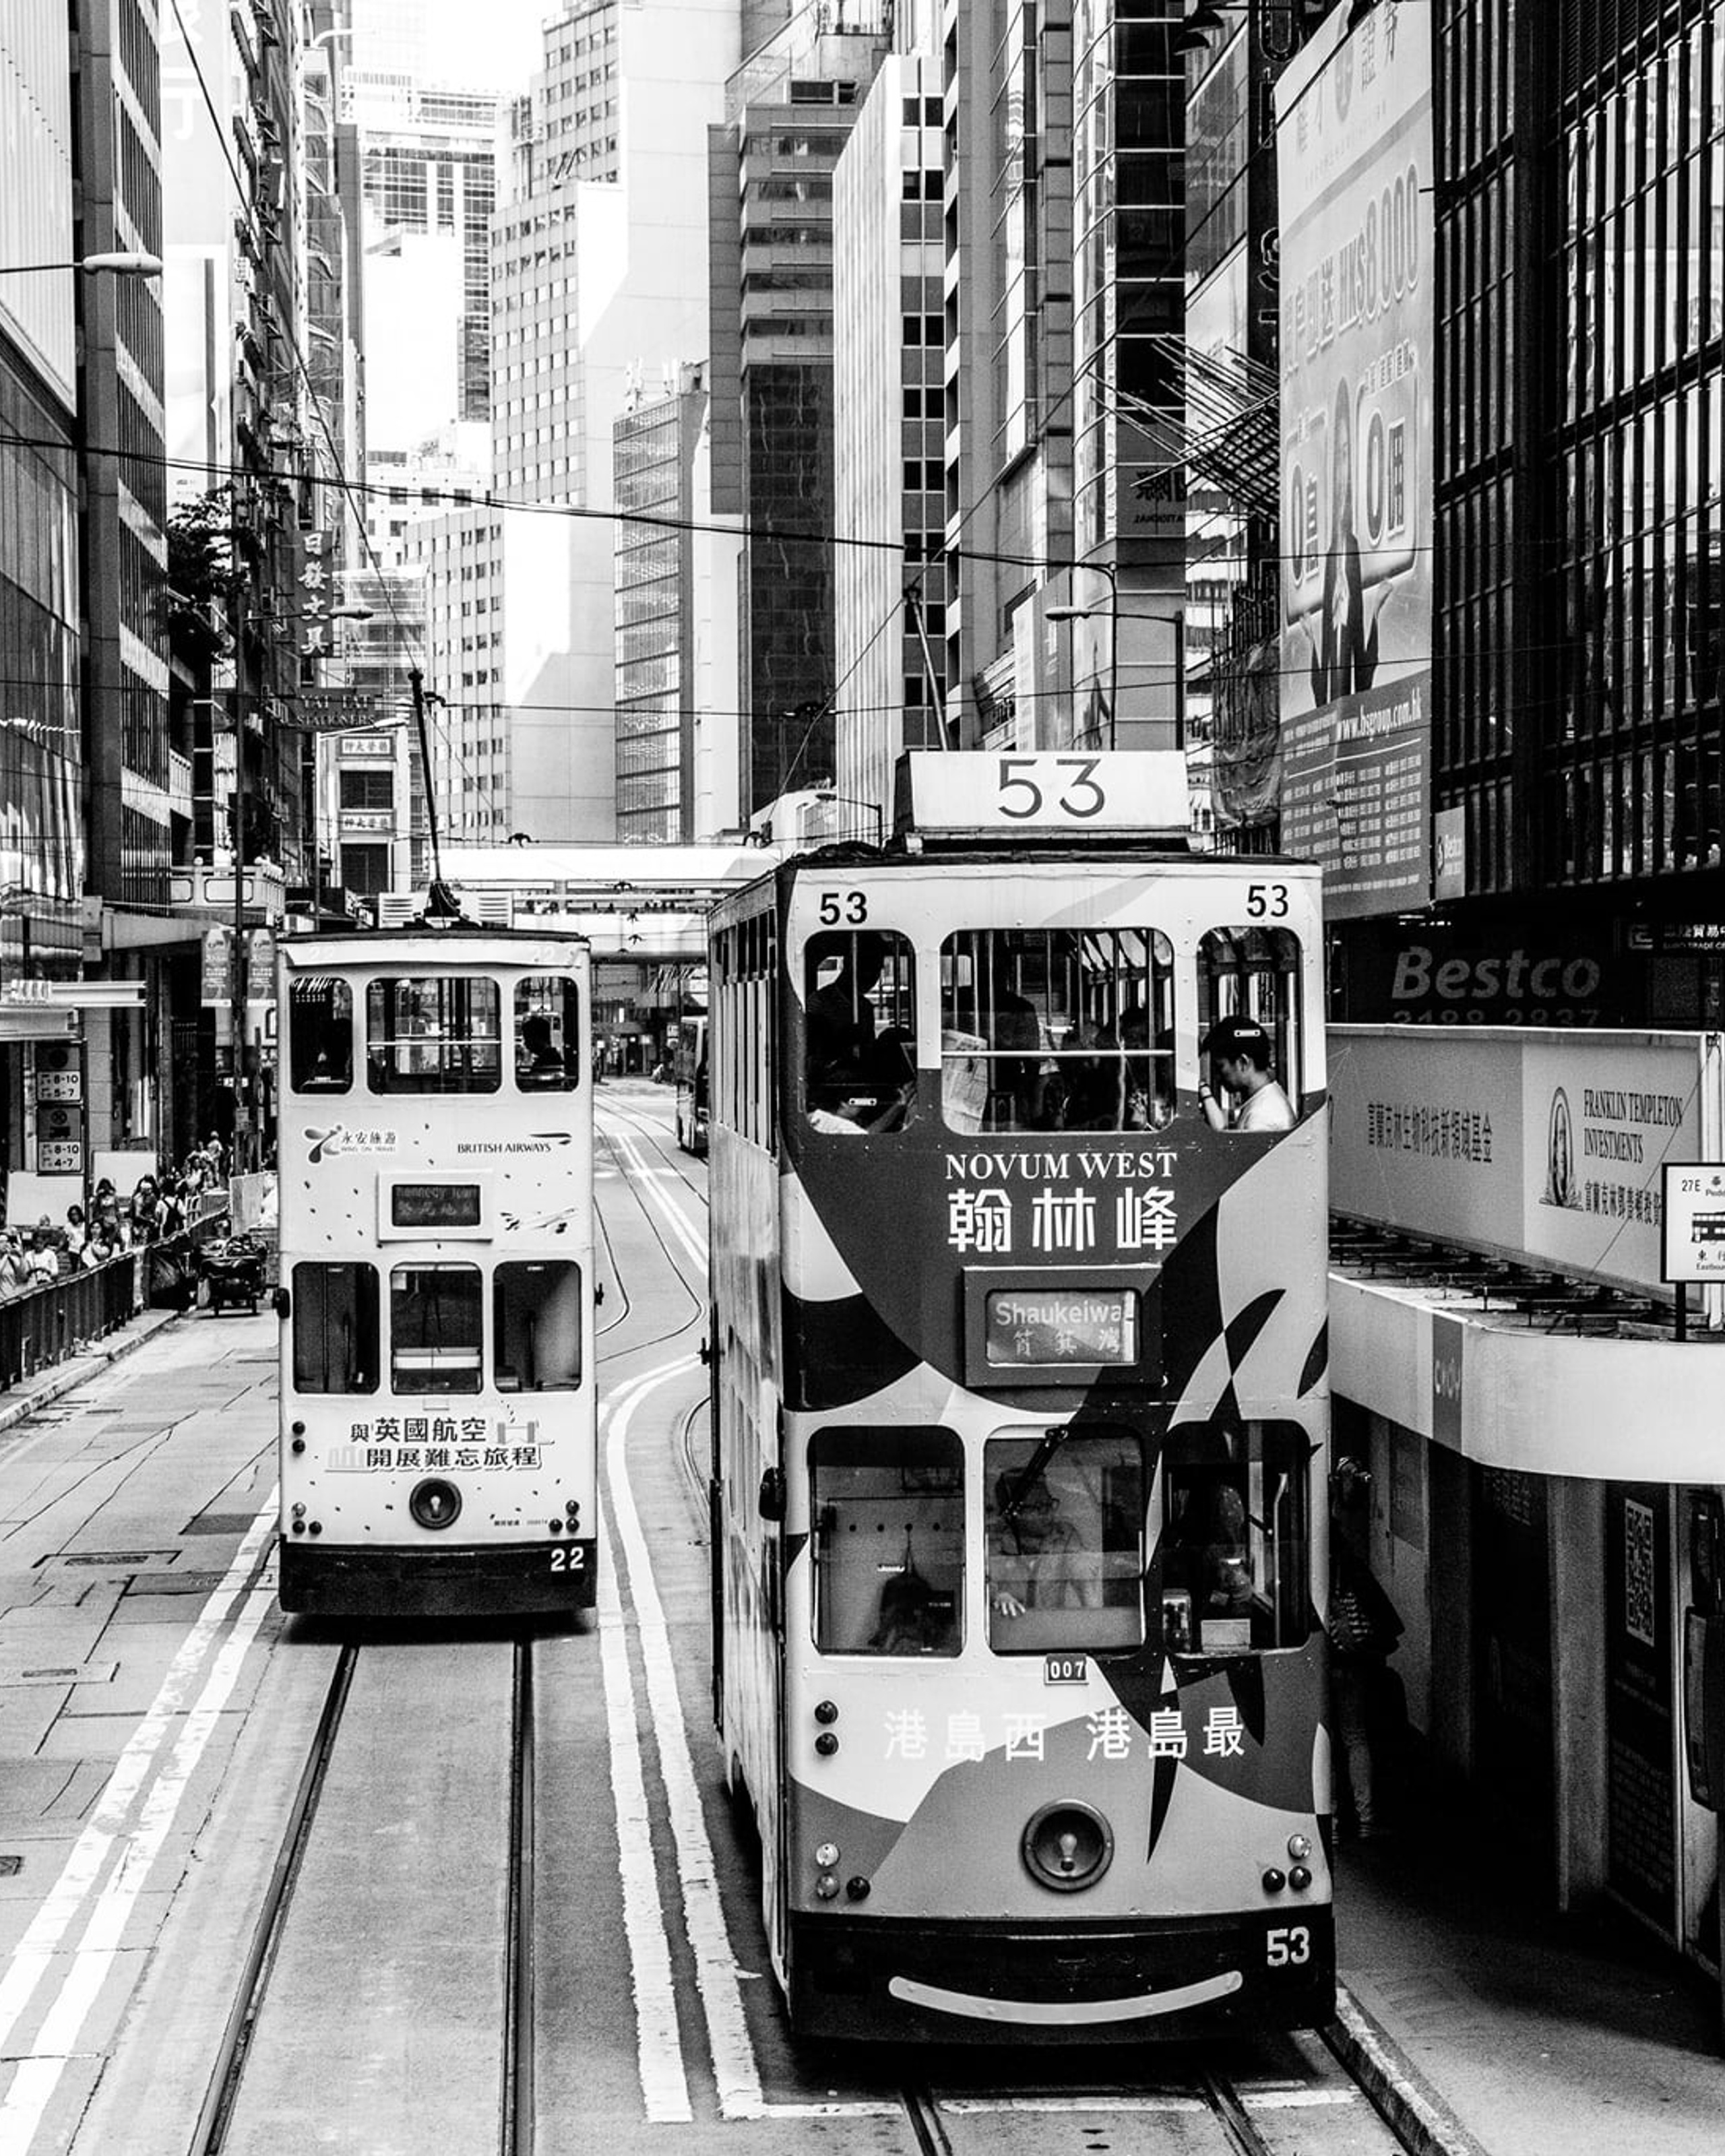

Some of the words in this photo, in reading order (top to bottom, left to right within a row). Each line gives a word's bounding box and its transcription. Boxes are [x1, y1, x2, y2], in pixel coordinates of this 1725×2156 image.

[998, 759, 1105, 818] 53
[819, 892, 868, 925] 53
[1246, 885, 1288, 917] 53
[1391, 946, 1600, 998] Bestco
[1584, 1089, 1627, 1121] FRANKLIN
[1629, 1093, 1683, 1127] TEMPLETON
[458, 1143, 502, 1153] BRITISH
[505, 1142, 552, 1153] AIRWAYS
[1584, 1128, 1643, 1164] INVESTMENTS
[945, 1153, 1070, 1179] NOVUM
[1077, 1152, 1177, 1178] WEST
[1682, 1179, 1700, 1192] 27E
[947, 1186, 1178, 1253] 翰林峰
[995, 1301, 1123, 1326] Shaukeiwa
[350, 1417, 487, 1443] 與英國航空
[367, 1447, 538, 1467] 開展難忘旅程
[551, 1546, 584, 1572] 22
[1050, 1661, 1085, 1679] 007
[884, 1709, 1046, 1762] 港島西
[1086, 1705, 1246, 1760] 港島最
[1266, 1926, 1311, 1967] 53
